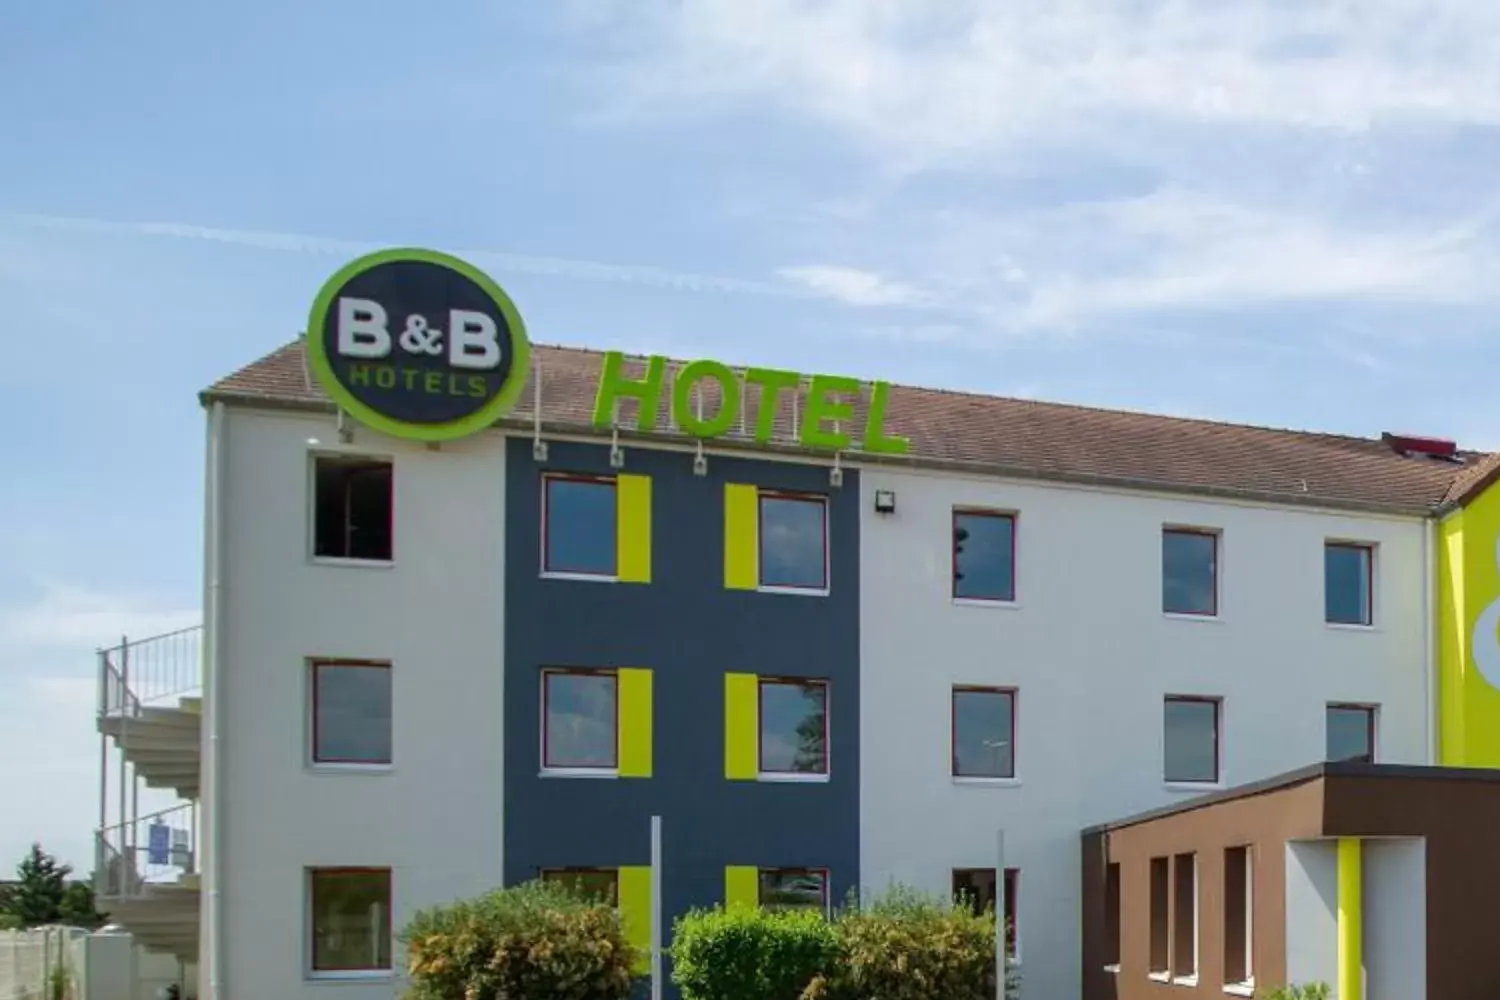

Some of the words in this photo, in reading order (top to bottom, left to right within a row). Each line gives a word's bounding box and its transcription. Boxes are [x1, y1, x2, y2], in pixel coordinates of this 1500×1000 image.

[338, 297, 500, 369] B&B
[351, 365, 487, 397] HOTELS
[592, 350, 909, 454] HOTEL
